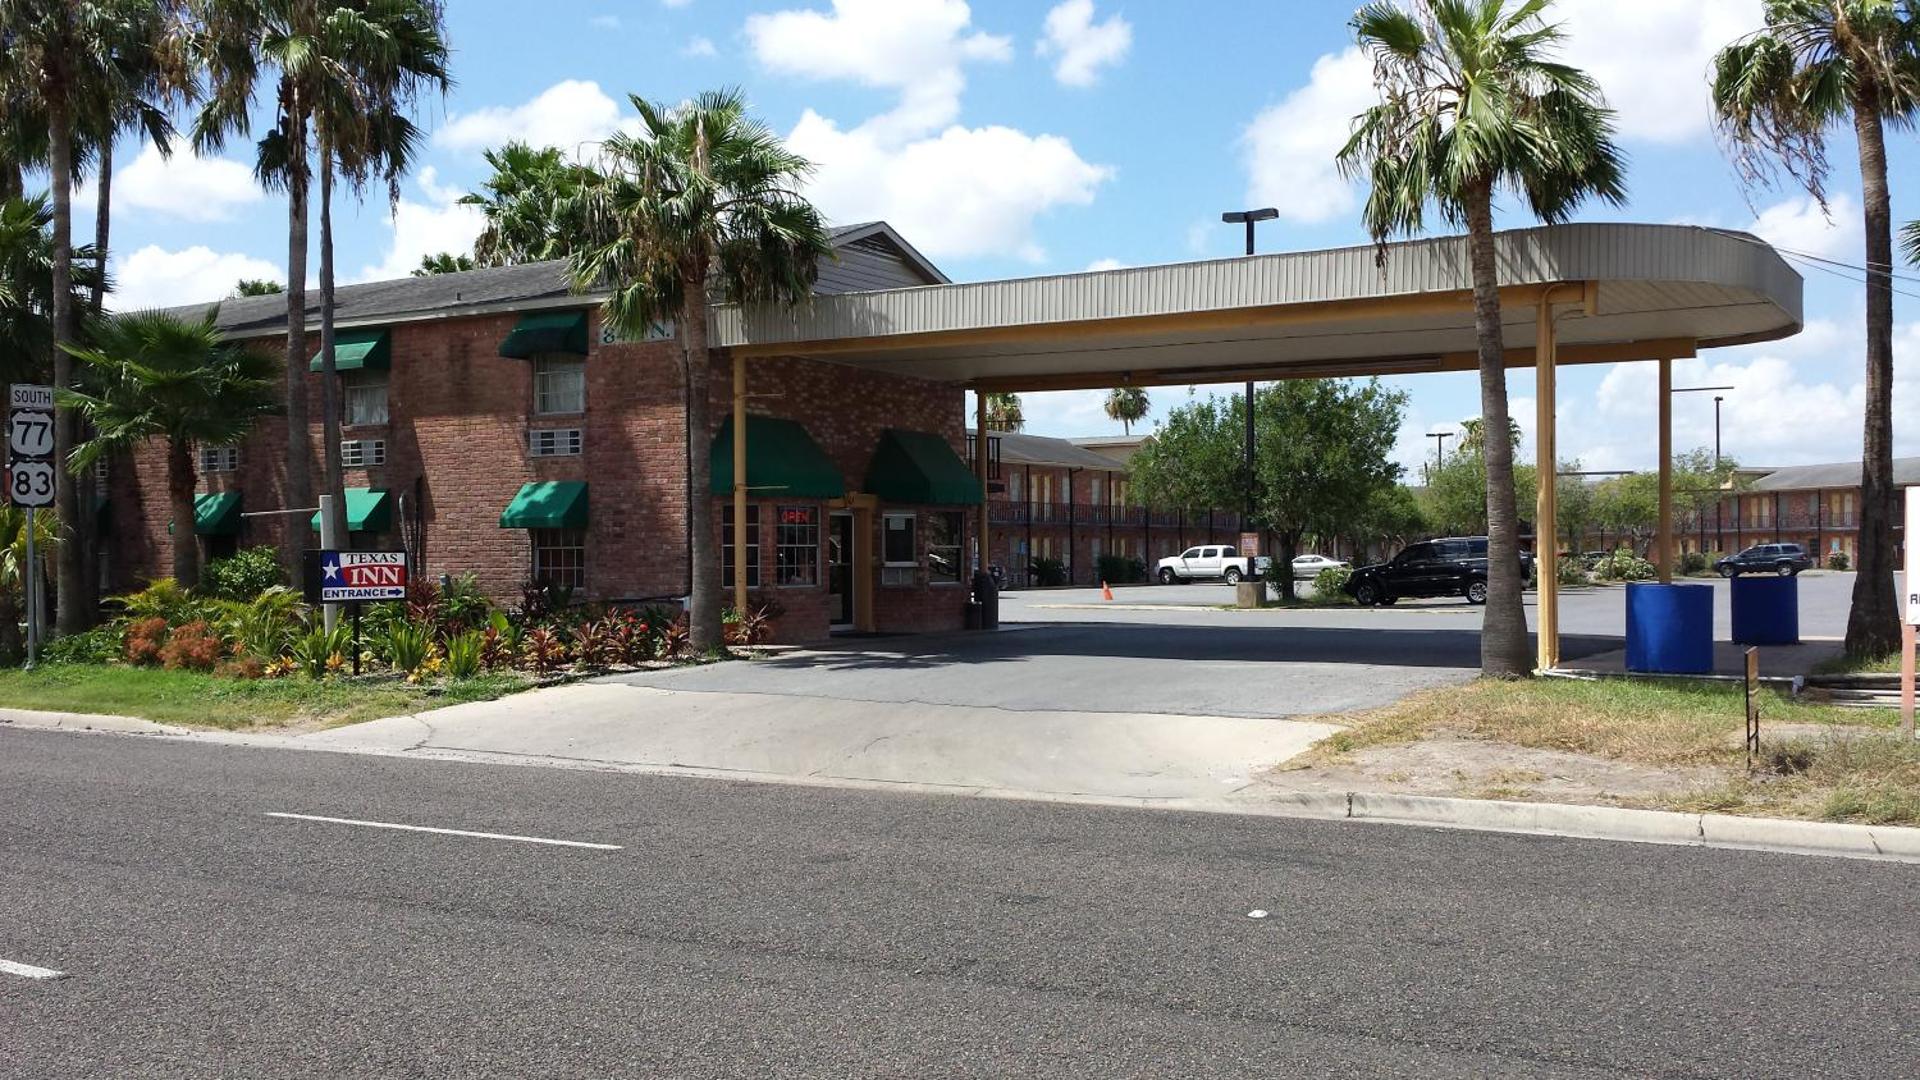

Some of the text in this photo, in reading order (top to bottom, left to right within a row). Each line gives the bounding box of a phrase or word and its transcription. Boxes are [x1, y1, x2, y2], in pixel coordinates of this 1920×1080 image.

[14, 390, 51, 404] SOUTH
[16, 420, 49, 446] 77
[15, 470, 50, 496] 83
[782, 510, 809, 523] OPEN
[346, 553, 398, 565] TEXAS
[350, 566, 400, 585] INN
[323, 588, 387, 598] ENTRANCE
